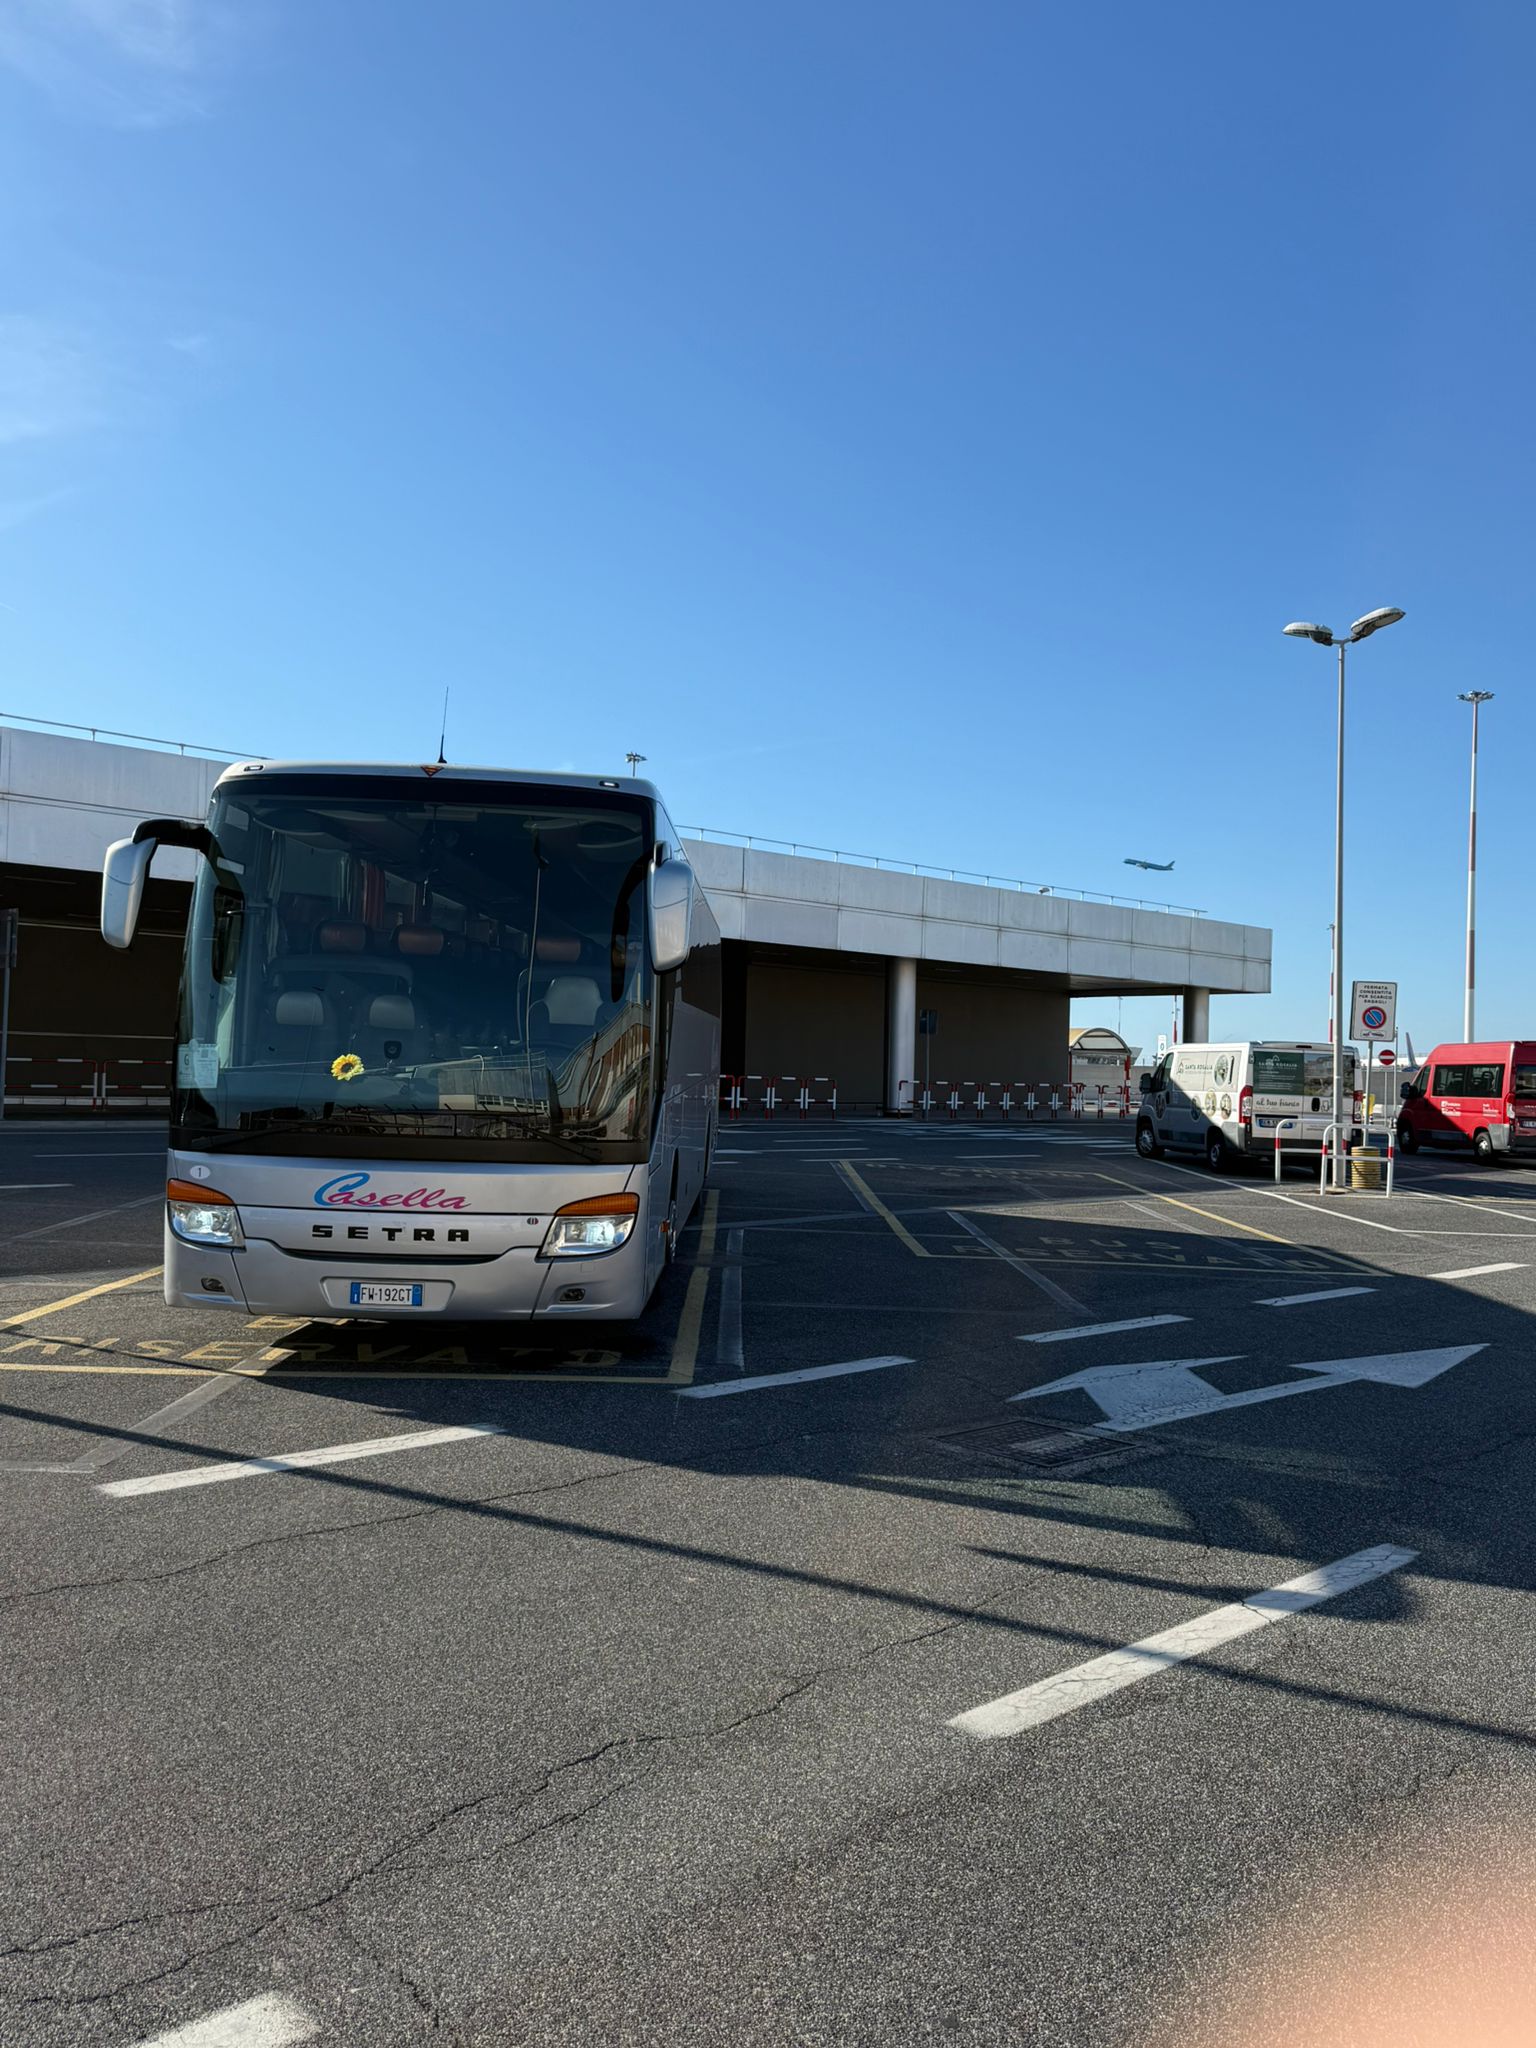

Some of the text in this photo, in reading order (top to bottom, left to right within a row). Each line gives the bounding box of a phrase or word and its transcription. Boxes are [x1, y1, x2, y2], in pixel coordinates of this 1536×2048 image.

[313, 1171, 472, 1210] Casella
[311, 1224, 470, 1242] SETRA
[1038, 1236, 1182, 1249] BUS
